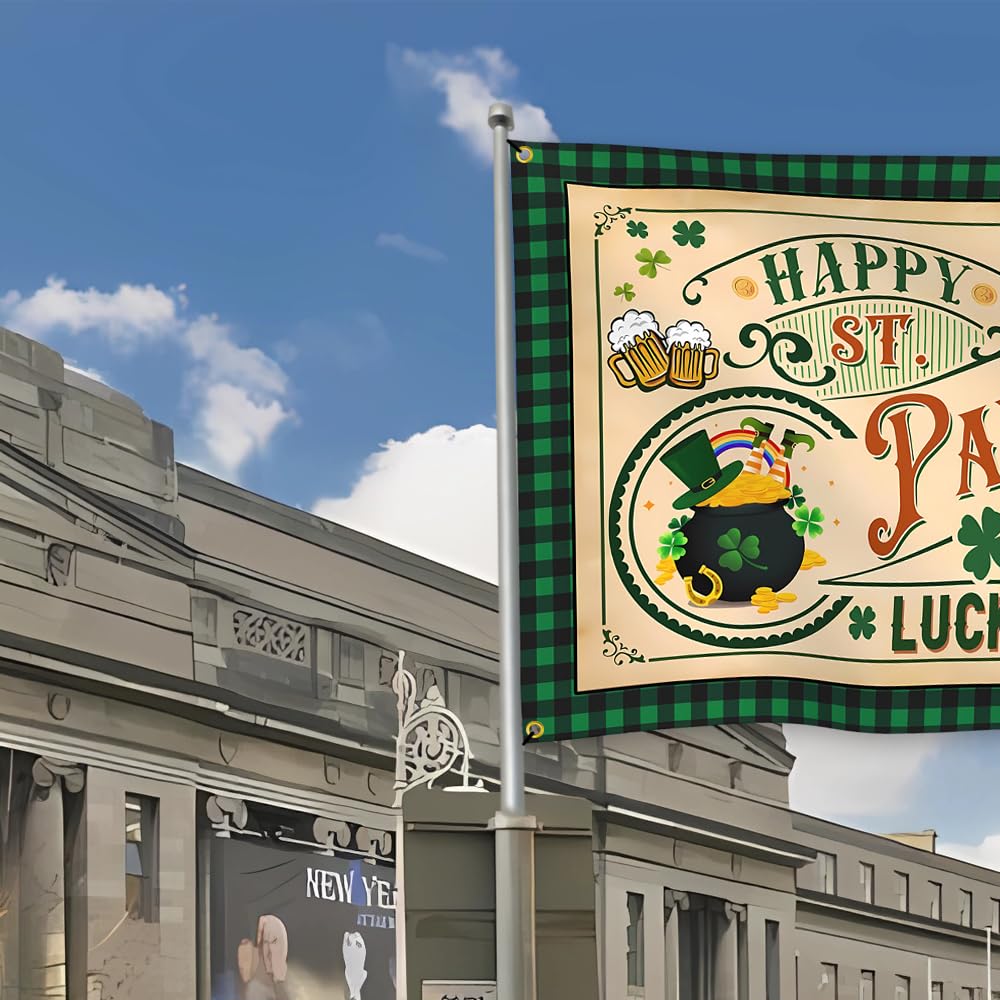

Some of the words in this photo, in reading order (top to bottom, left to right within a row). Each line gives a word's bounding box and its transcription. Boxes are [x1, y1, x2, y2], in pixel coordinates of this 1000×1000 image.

[759, 241, 972, 305] HAPPY
[831, 314, 930, 369] ST.
[306, 867, 355, 904] NEW
